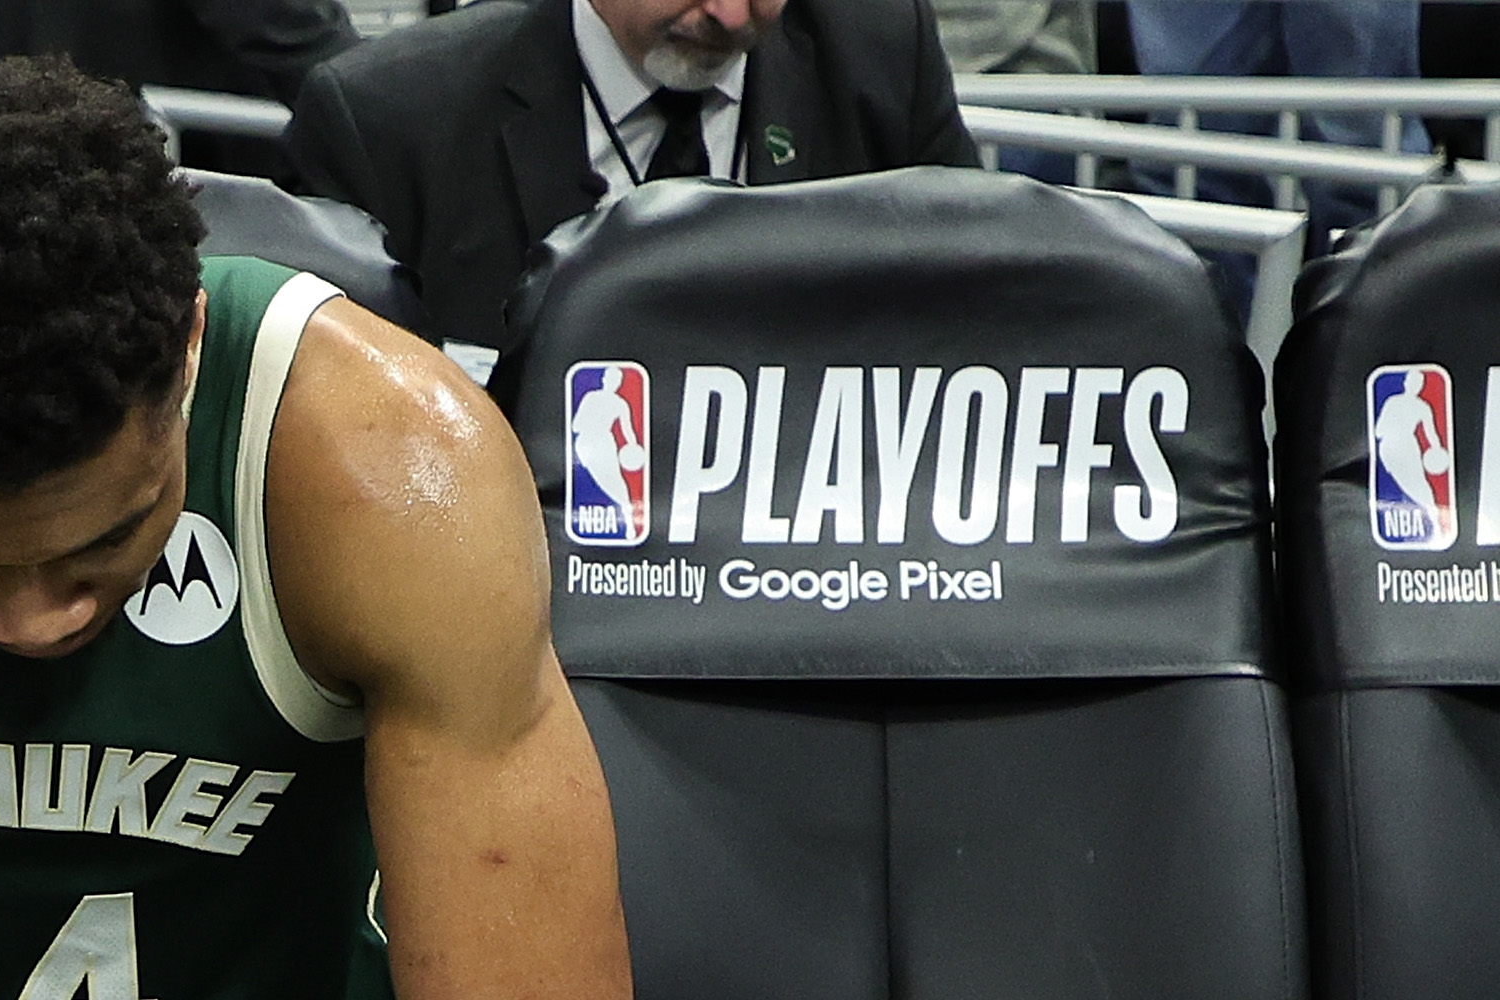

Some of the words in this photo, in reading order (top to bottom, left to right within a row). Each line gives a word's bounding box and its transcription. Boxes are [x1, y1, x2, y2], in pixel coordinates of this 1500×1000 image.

[668, 365, 1189, 545] PLAYOFFS
[578, 505, 618, 535] NBA
[1385, 510, 1425, 538] NBA
[568, 555, 676, 598] Presented
[681, 559, 706, 604] by
[719, 560, 888, 611] Google
[899, 560, 1002, 600] Pixel
[1378, 562, 1488, 603] Presented
